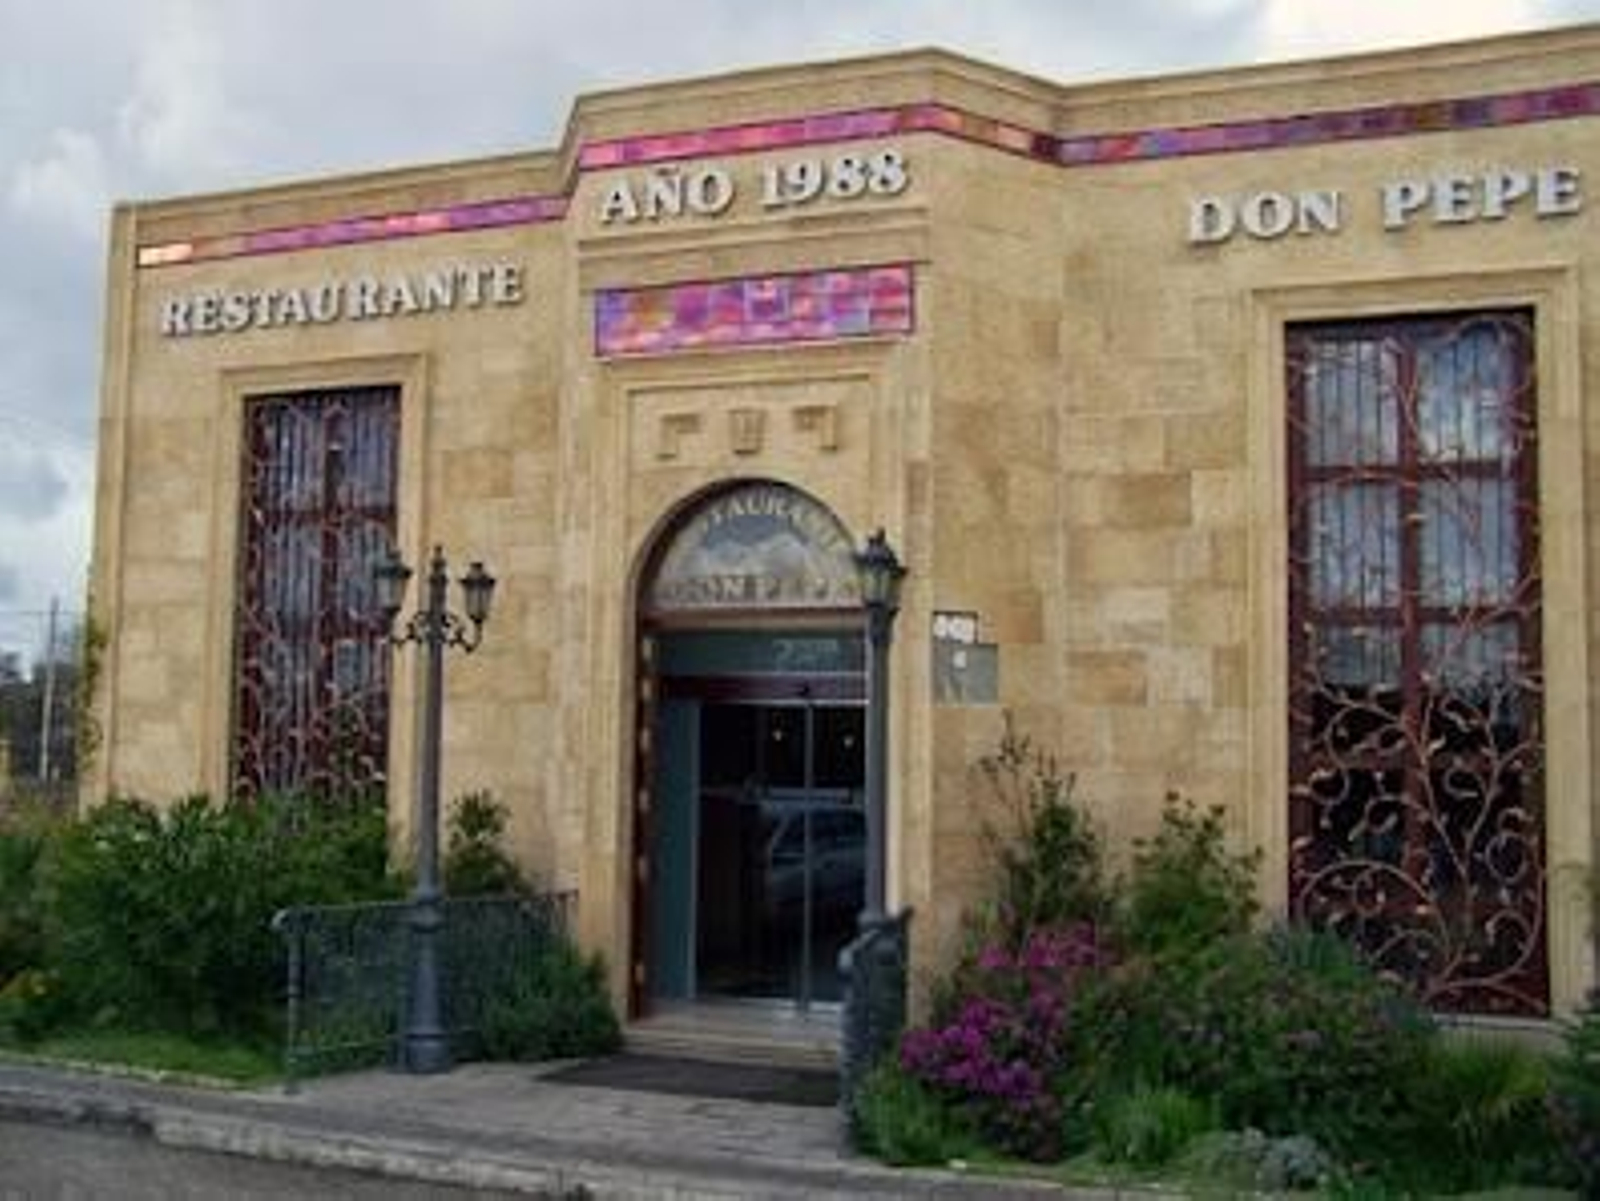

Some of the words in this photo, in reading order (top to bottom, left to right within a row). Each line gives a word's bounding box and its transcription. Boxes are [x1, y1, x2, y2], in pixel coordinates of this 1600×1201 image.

[601, 166, 734, 223] AÑO
[762, 149, 908, 210] 1988
[1189, 190, 1341, 244] DON
[1382, 166, 1582, 232] PEPE
[160, 262, 524, 336] RESTAURANTE
